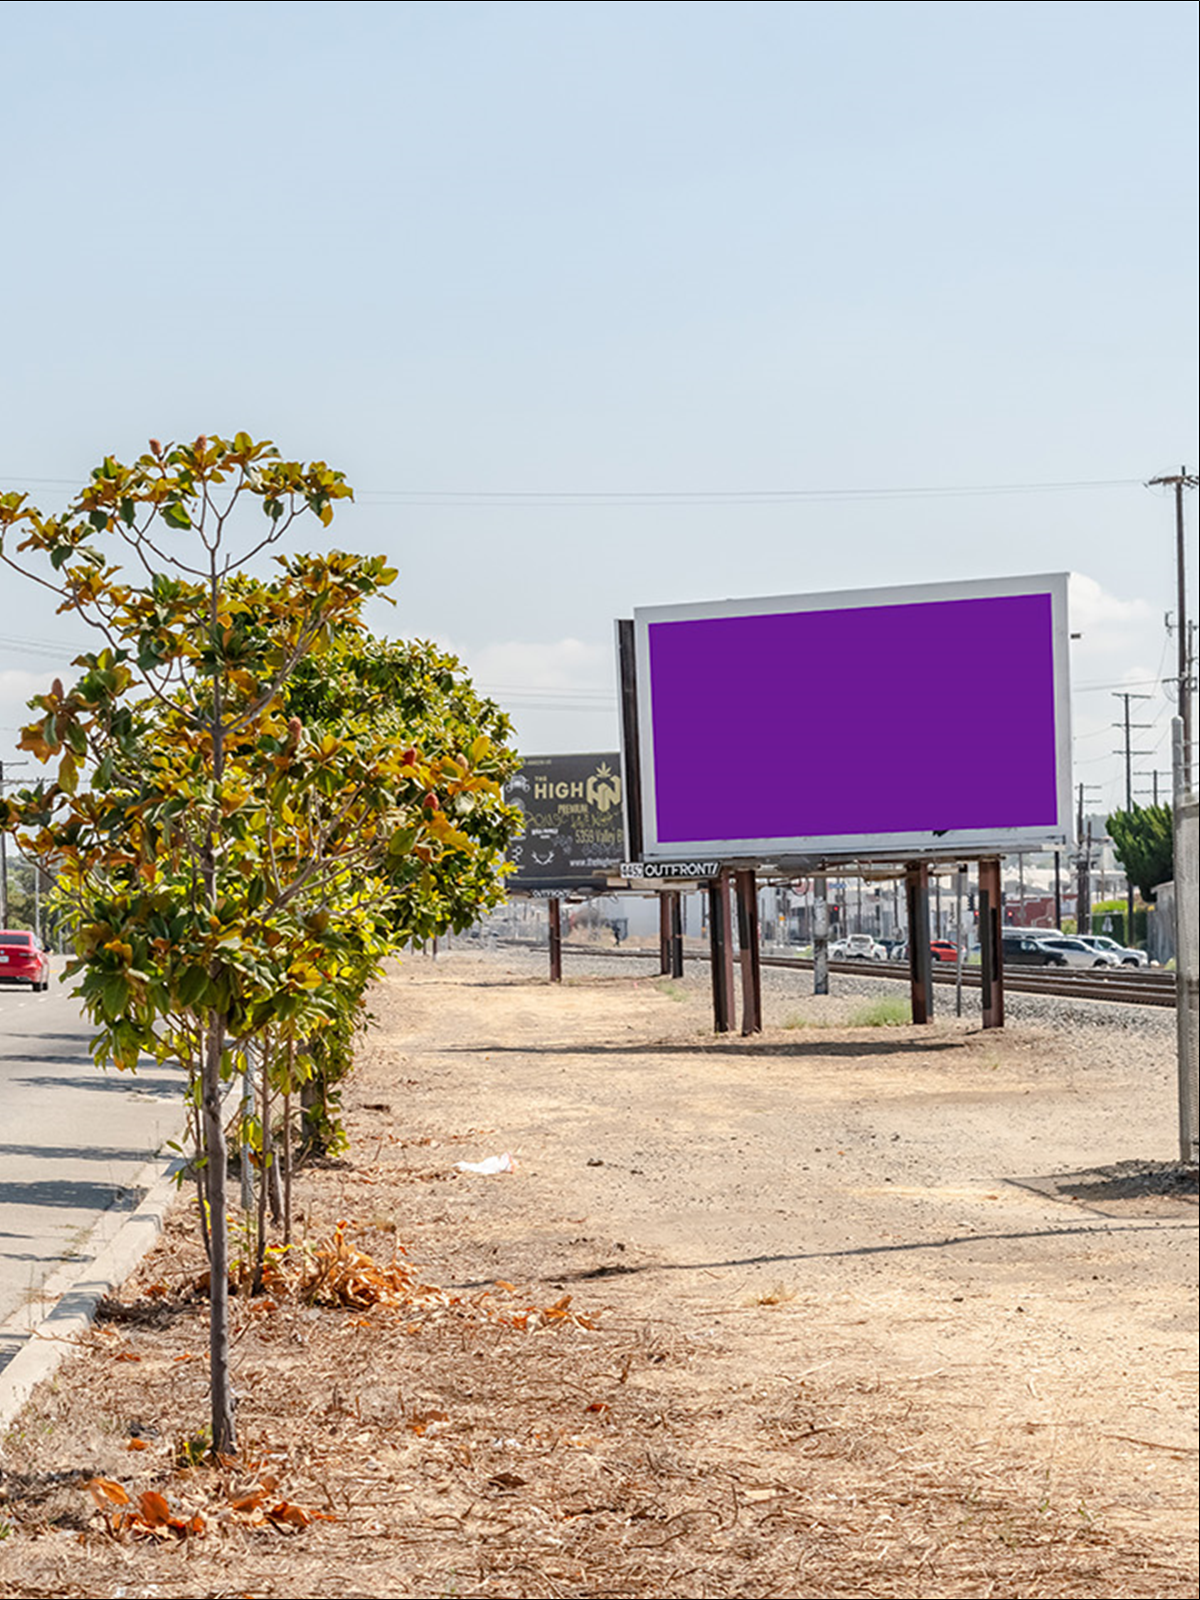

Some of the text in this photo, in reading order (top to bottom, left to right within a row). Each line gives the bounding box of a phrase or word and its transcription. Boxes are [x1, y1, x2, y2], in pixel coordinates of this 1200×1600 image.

[534, 781, 584, 800] HIGH
[557, 803, 589, 815] PREMIUM
[595, 828, 615, 847] Valley
